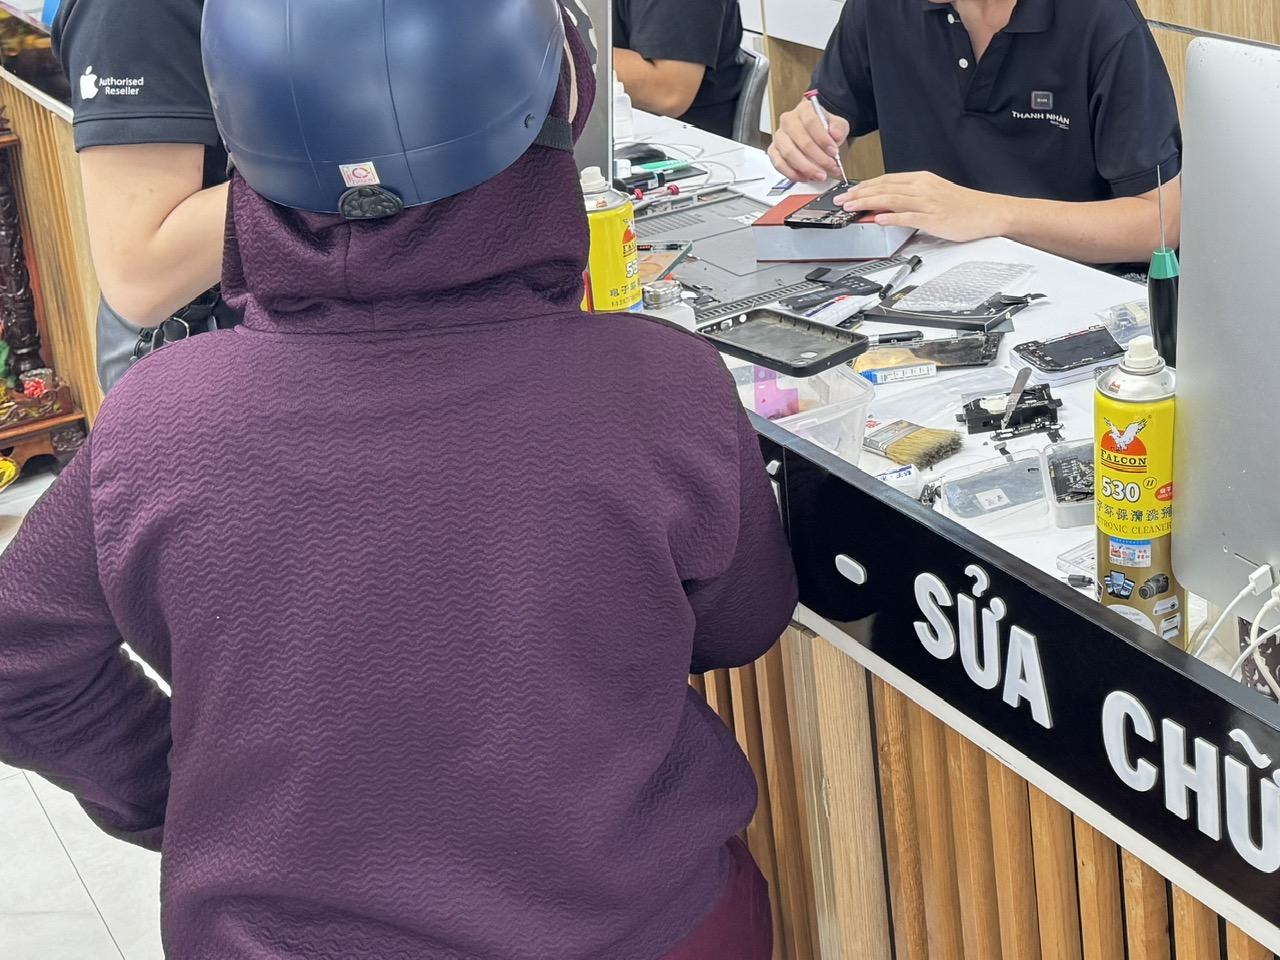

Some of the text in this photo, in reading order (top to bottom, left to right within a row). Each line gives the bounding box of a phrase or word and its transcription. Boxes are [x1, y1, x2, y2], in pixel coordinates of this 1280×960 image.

[99, 76, 144, 86] Authorised
[105, 86, 140, 95] Reseller
[1011, 110, 1044, 120] THANH
[1101, 448, 1147, 465] FALCON
[1101, 476, 1141, 502] 530
[913, 564, 1054, 729] SỬA
